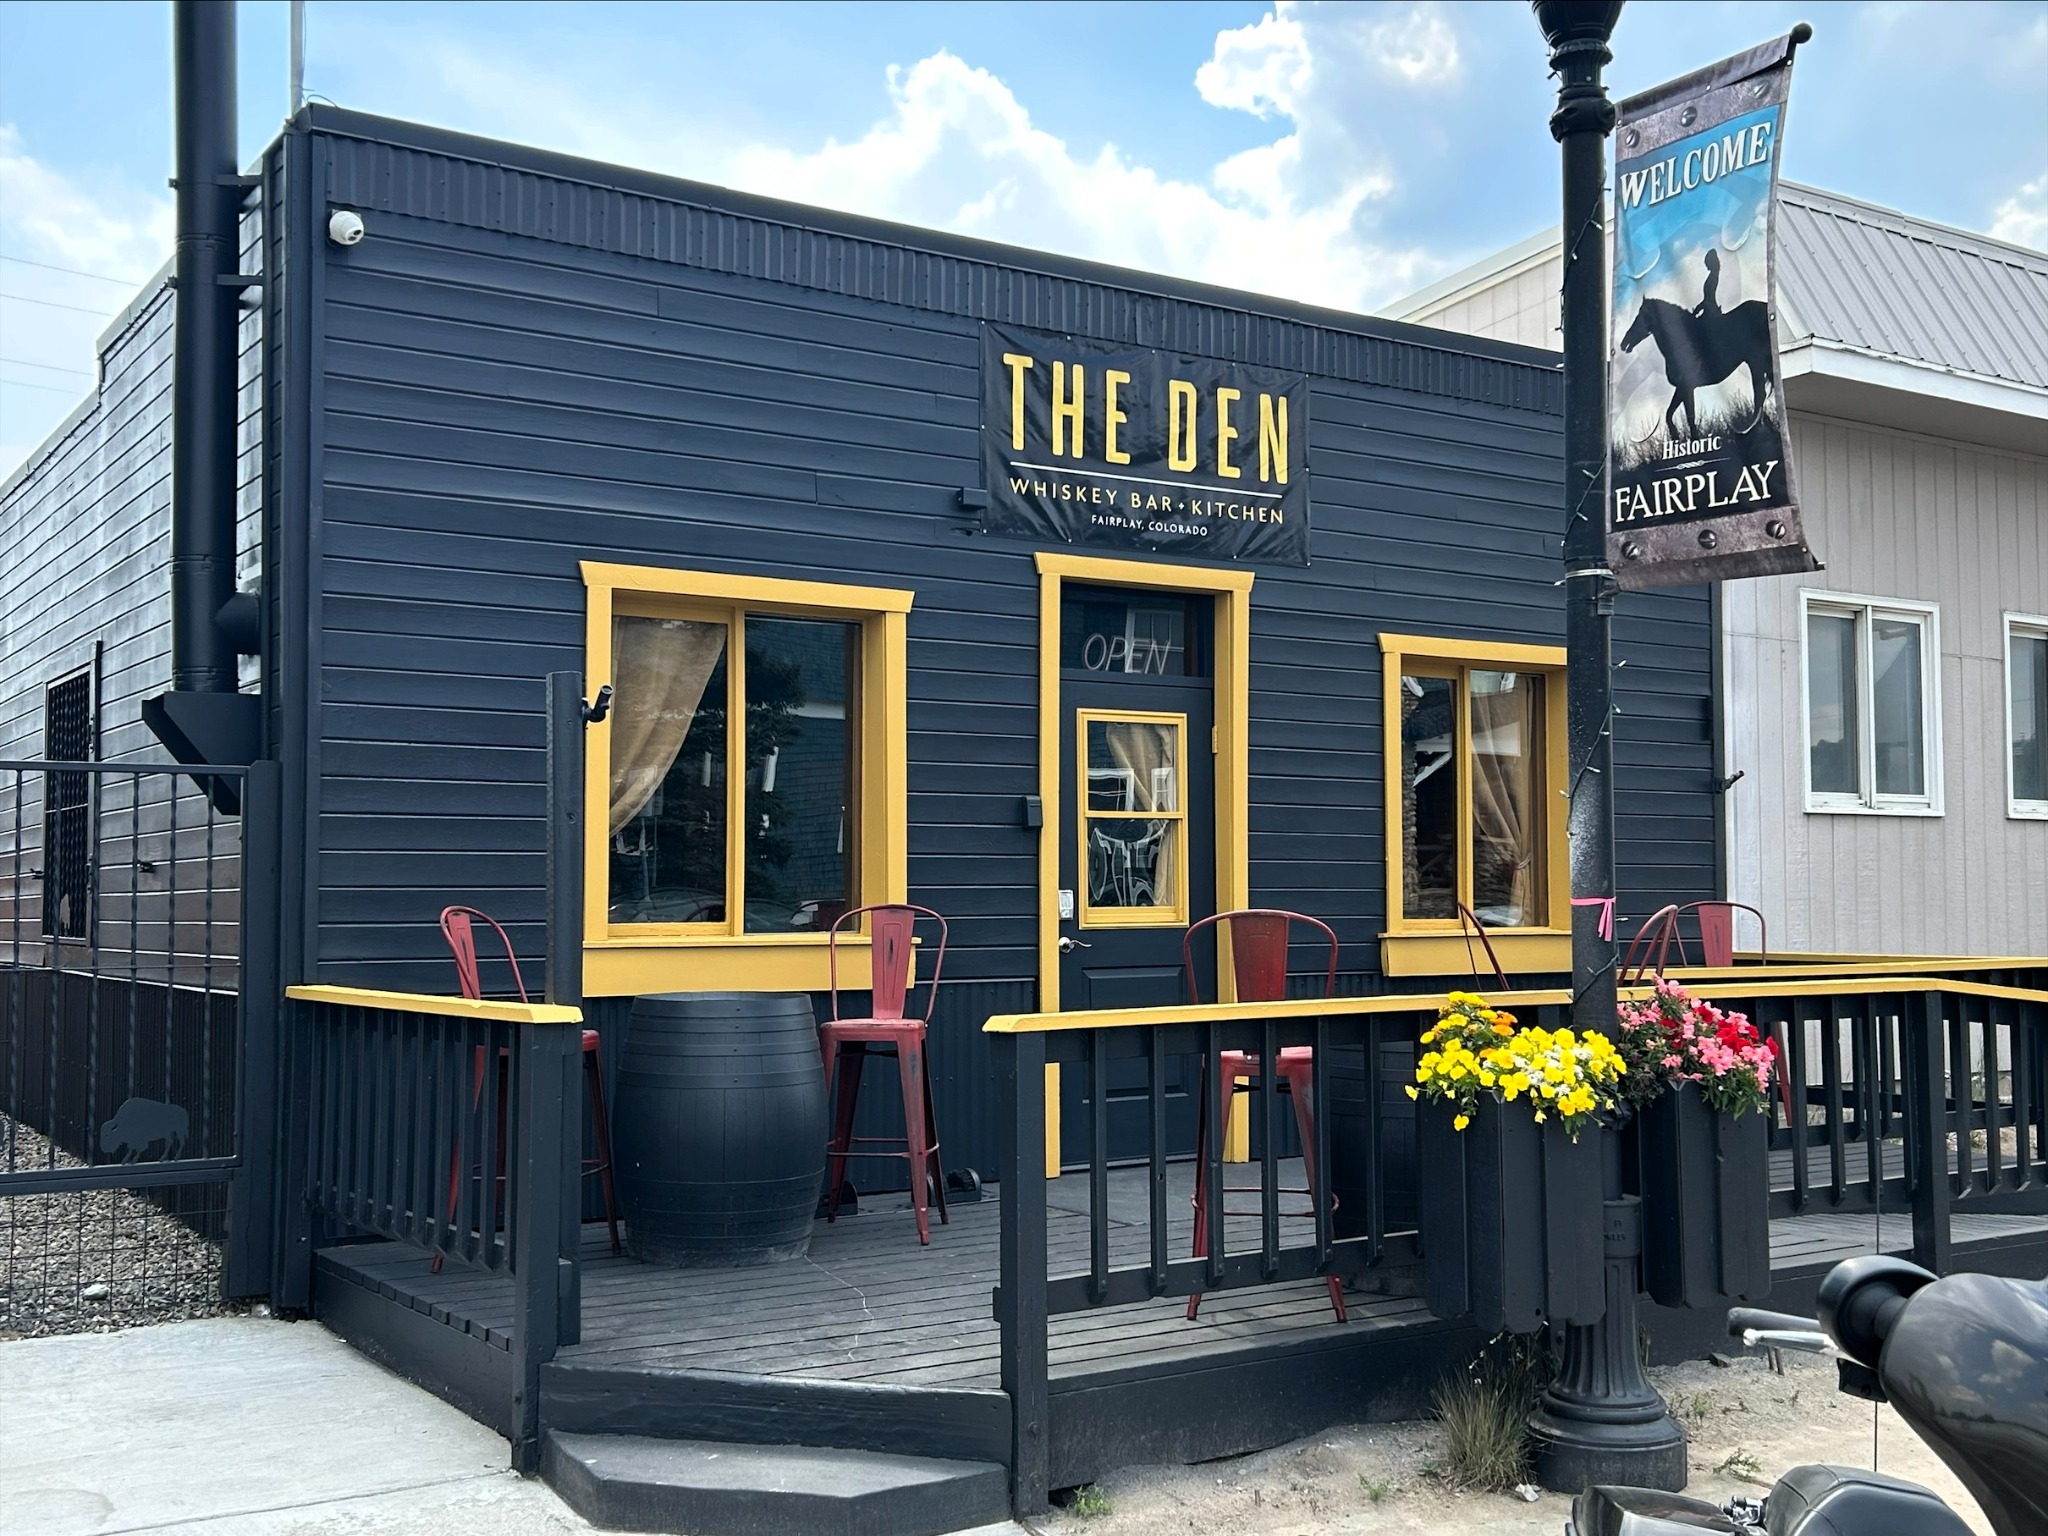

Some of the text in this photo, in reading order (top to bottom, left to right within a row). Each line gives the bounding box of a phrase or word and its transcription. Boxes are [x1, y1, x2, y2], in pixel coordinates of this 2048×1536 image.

[1620, 121, 1771, 210] WELCOME
[1003, 353, 1288, 484] THE DEN
[1662, 433, 1722, 460] Historic
[1009, 477, 1118, 506] WHISKEY
[1615, 460, 1779, 522] FAIRPLAY
[1091, 514, 1208, 537] FAIRPLAY, COLORADO
[1082, 633, 1171, 676] OPEN
